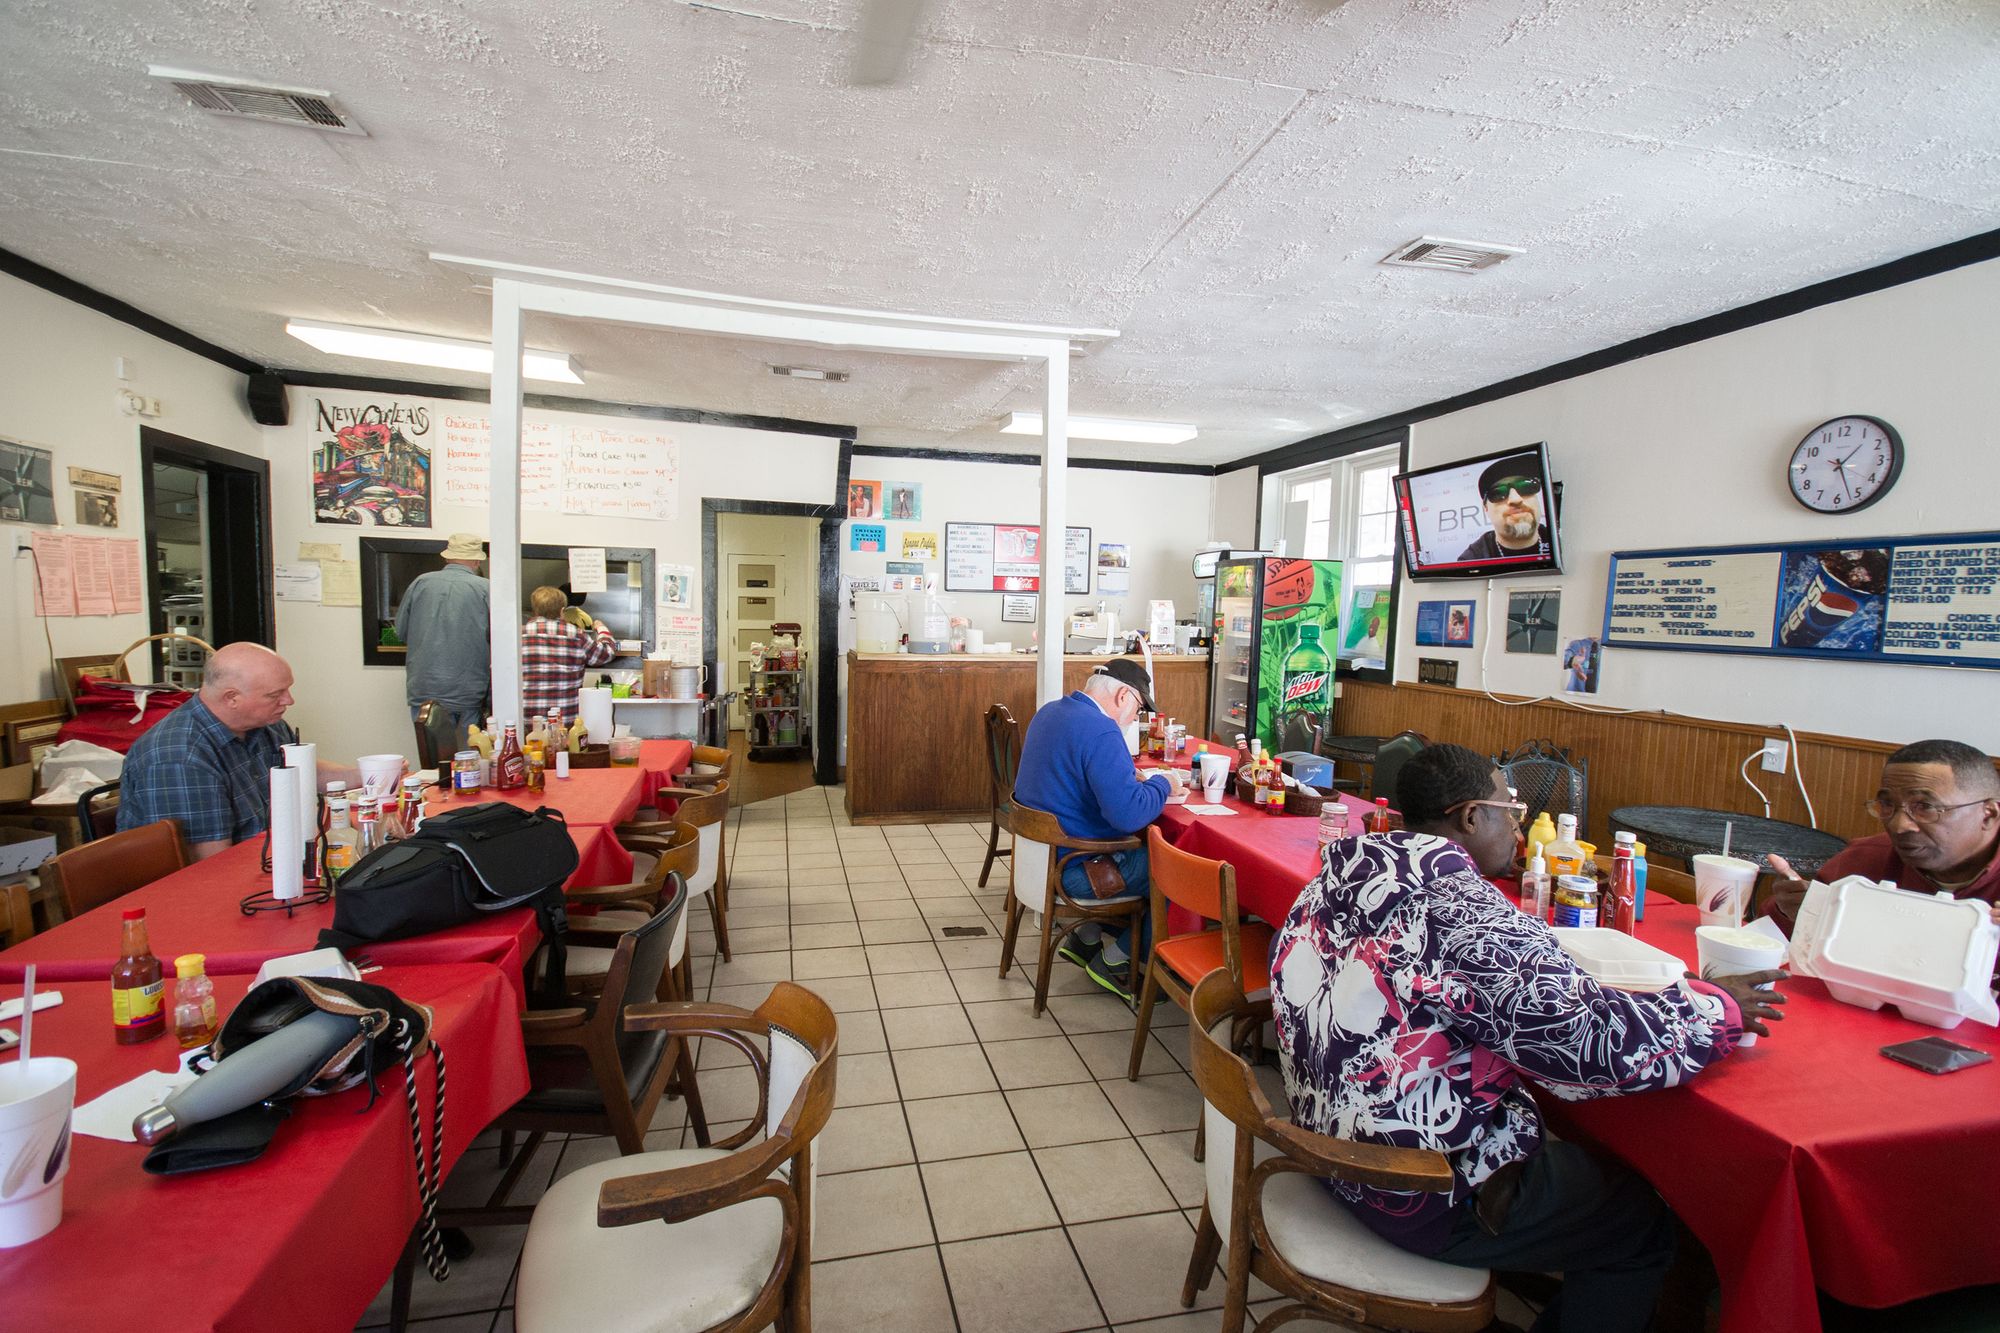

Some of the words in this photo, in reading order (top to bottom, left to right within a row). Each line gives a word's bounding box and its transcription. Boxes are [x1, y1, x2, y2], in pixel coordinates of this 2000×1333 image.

[1838, 426, 1851, 437] 12
[1862, 428, 1867, 439] 1
[1823, 432, 1832, 443] 11
[1874, 439, 1882, 450] 2
[1807, 446, 1819, 458] 10
[1877, 454, 1885, 466] 3
[1800, 464, 1808, 474] 9
[1867, 472, 1875, 483] 4
[1803, 479, 1811, 490] 8
[1817, 489, 1824, 501] 7
[1854, 487, 1862, 498] 5
[1834, 494, 1841, 504] 6
[1896, 550, 1930, 559] STEAK
[1895, 559, 1923, 568] FRIED
[1926, 559, 1941, 567] OR
[1945, 558, 1981, 567] BAKED
[1893, 568, 1927, 577] WHITE
[1892, 578, 1922, 586] FRIED
[1781, 574, 1826, 645] PEPSI
[1947, 613, 1992, 622] CHOICE
[1887, 622, 1941, 631] BROCCOLI
[1951, 623, 2000, 632] SQUASH
[1884, 639, 1940, 649] BUTTERED
[1946, 641, 1961, 649] OR
[1421, 663, 1435, 679] GOD
[1435, 664, 1448, 680] DID
[1448, 665, 1457, 681] IT
